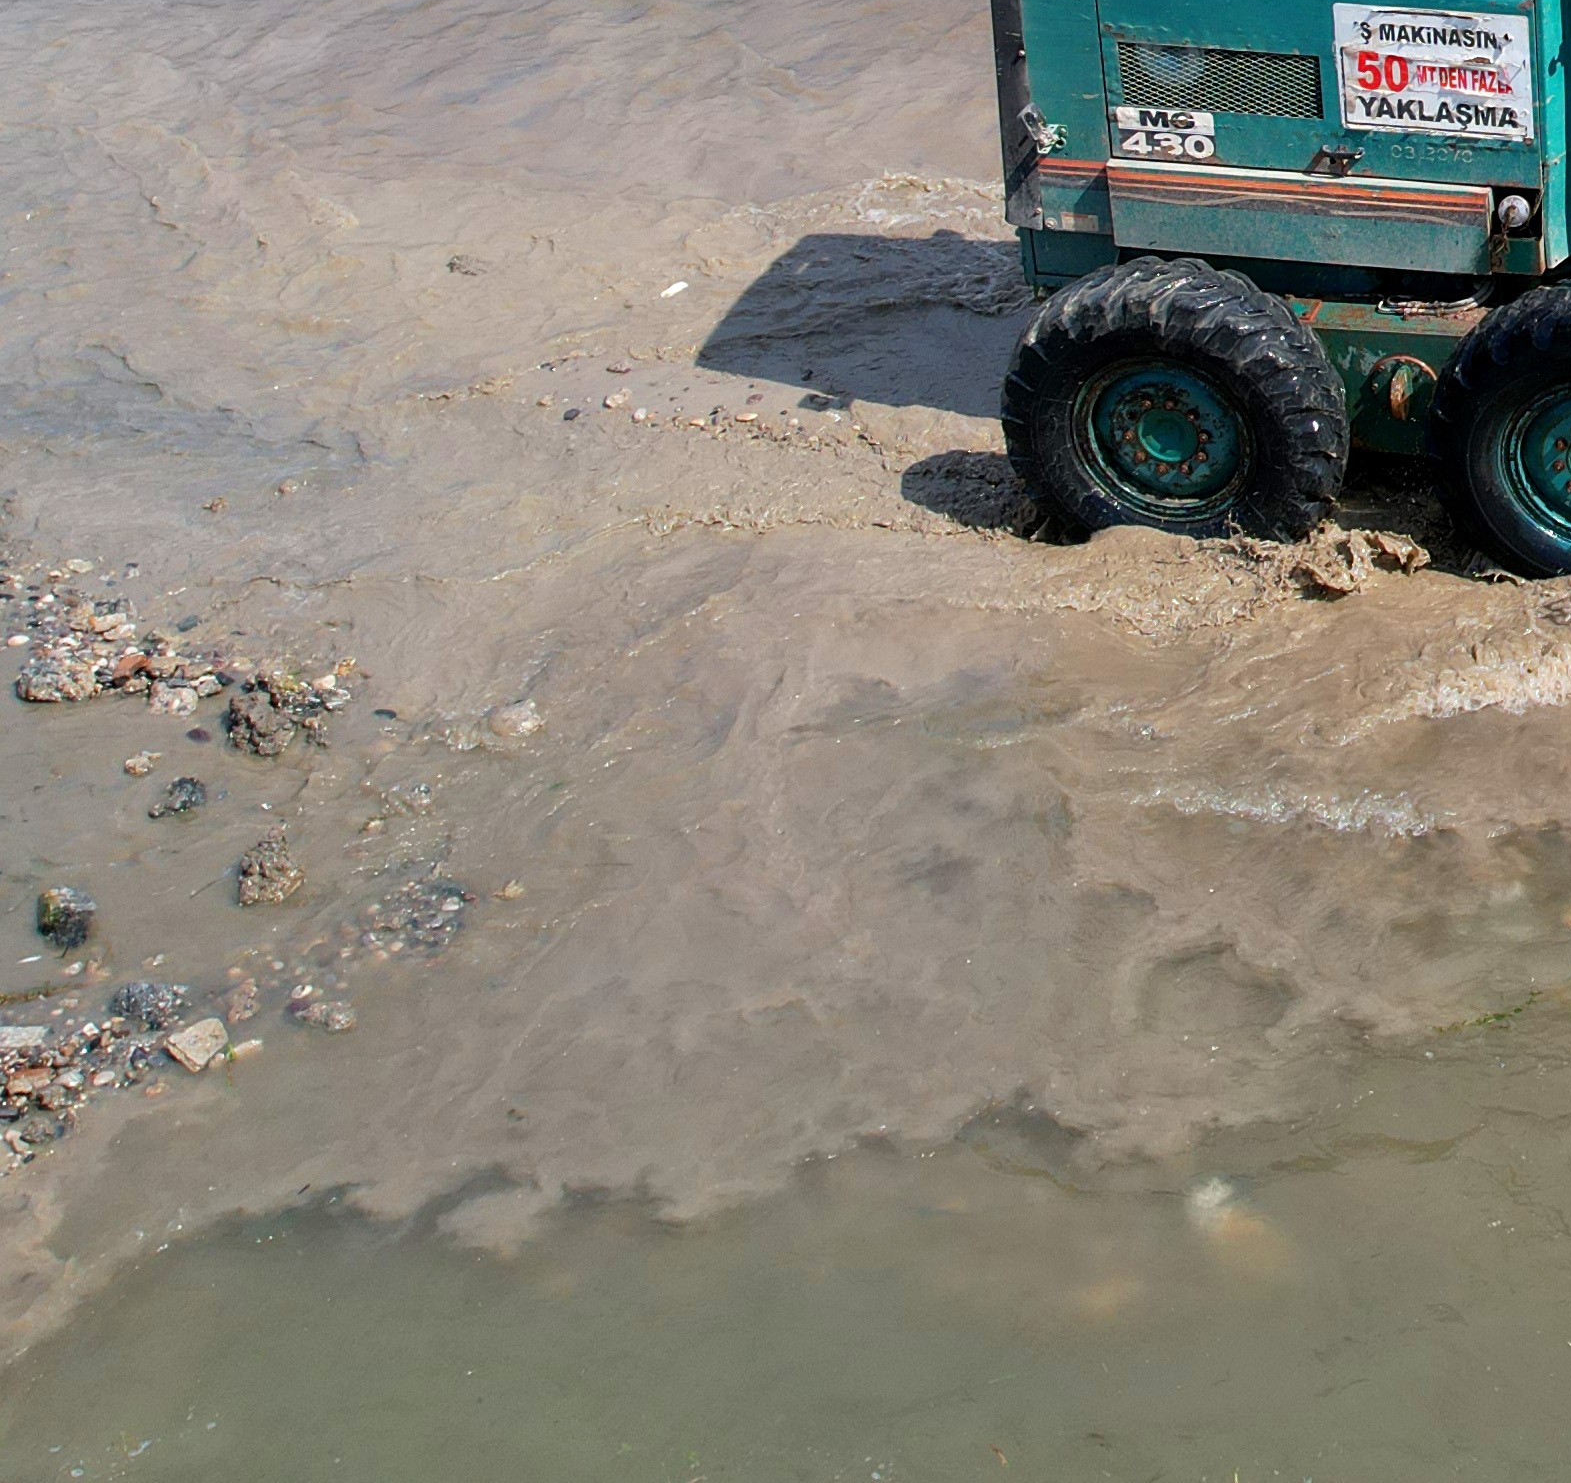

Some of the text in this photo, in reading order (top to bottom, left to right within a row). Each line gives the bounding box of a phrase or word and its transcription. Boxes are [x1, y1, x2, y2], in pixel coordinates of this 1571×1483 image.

[1352, 21, 1372, 44] Ş
[1357, 50, 1409, 93] 50
[1356, 95, 1519, 130] YAKLAŞMA
[1122, 131, 1215, 159] 430
